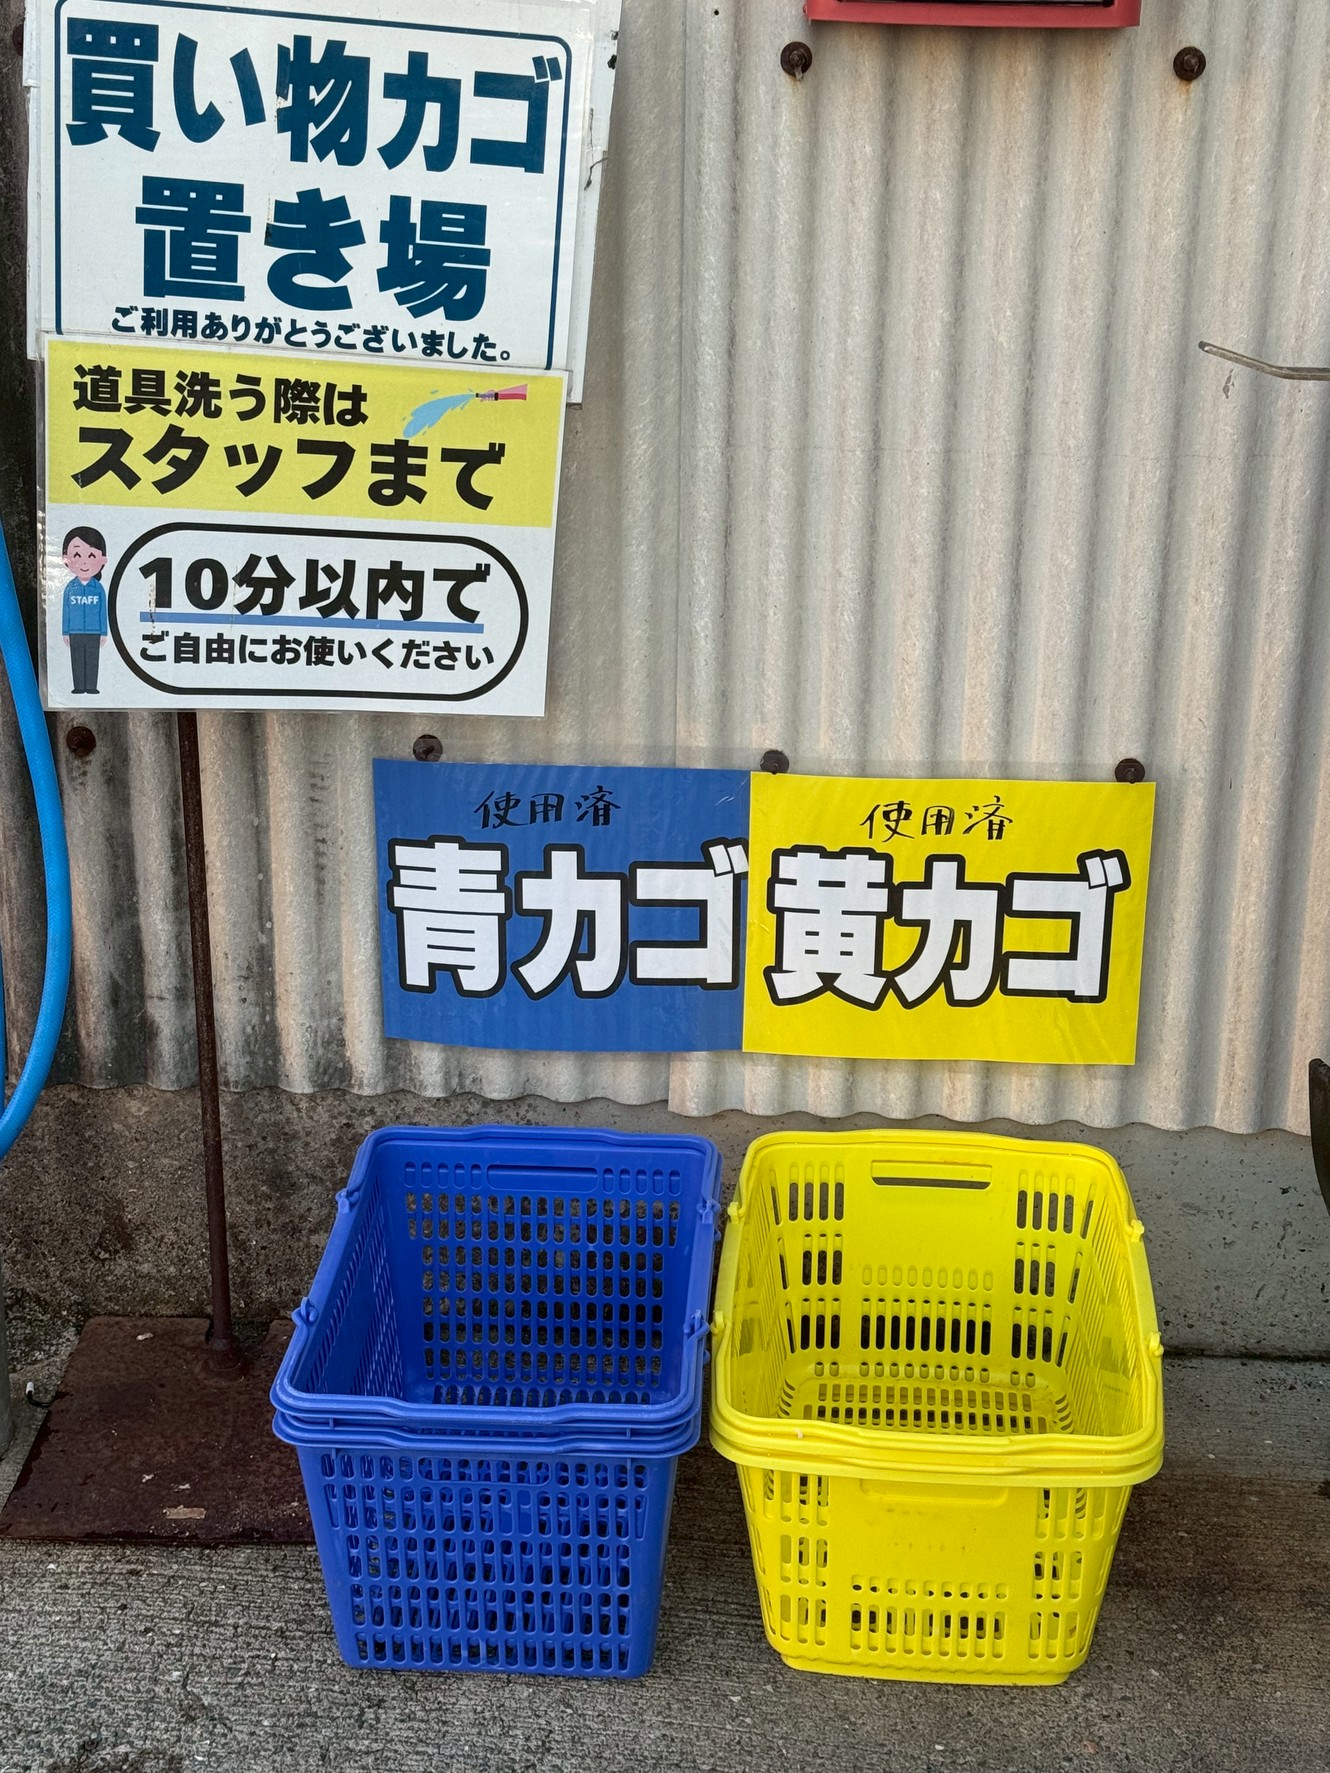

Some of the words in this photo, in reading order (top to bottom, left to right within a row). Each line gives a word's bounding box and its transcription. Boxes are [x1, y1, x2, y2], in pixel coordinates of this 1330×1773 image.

[66, 17, 562, 173] 買い物カゴ
[135, 175, 491, 322] 置き場
[111, 305, 510, 362] ご利用ありがとうございました。
[73, 364, 368, 427] 道具洗う際は
[70, 424, 506, 510] スタッフまで
[70, 595, 99, 605] STAFF
[139, 553, 491, 623] 10分以内で
[139, 630, 494, 671] ご自由にお使いください
[473, 785, 622, 829] 使用済
[860, 795, 1014, 841] 使用済
[388, 835, 748, 998] 青カゴ
[764, 844, 1130, 1009] 黄カゴ
